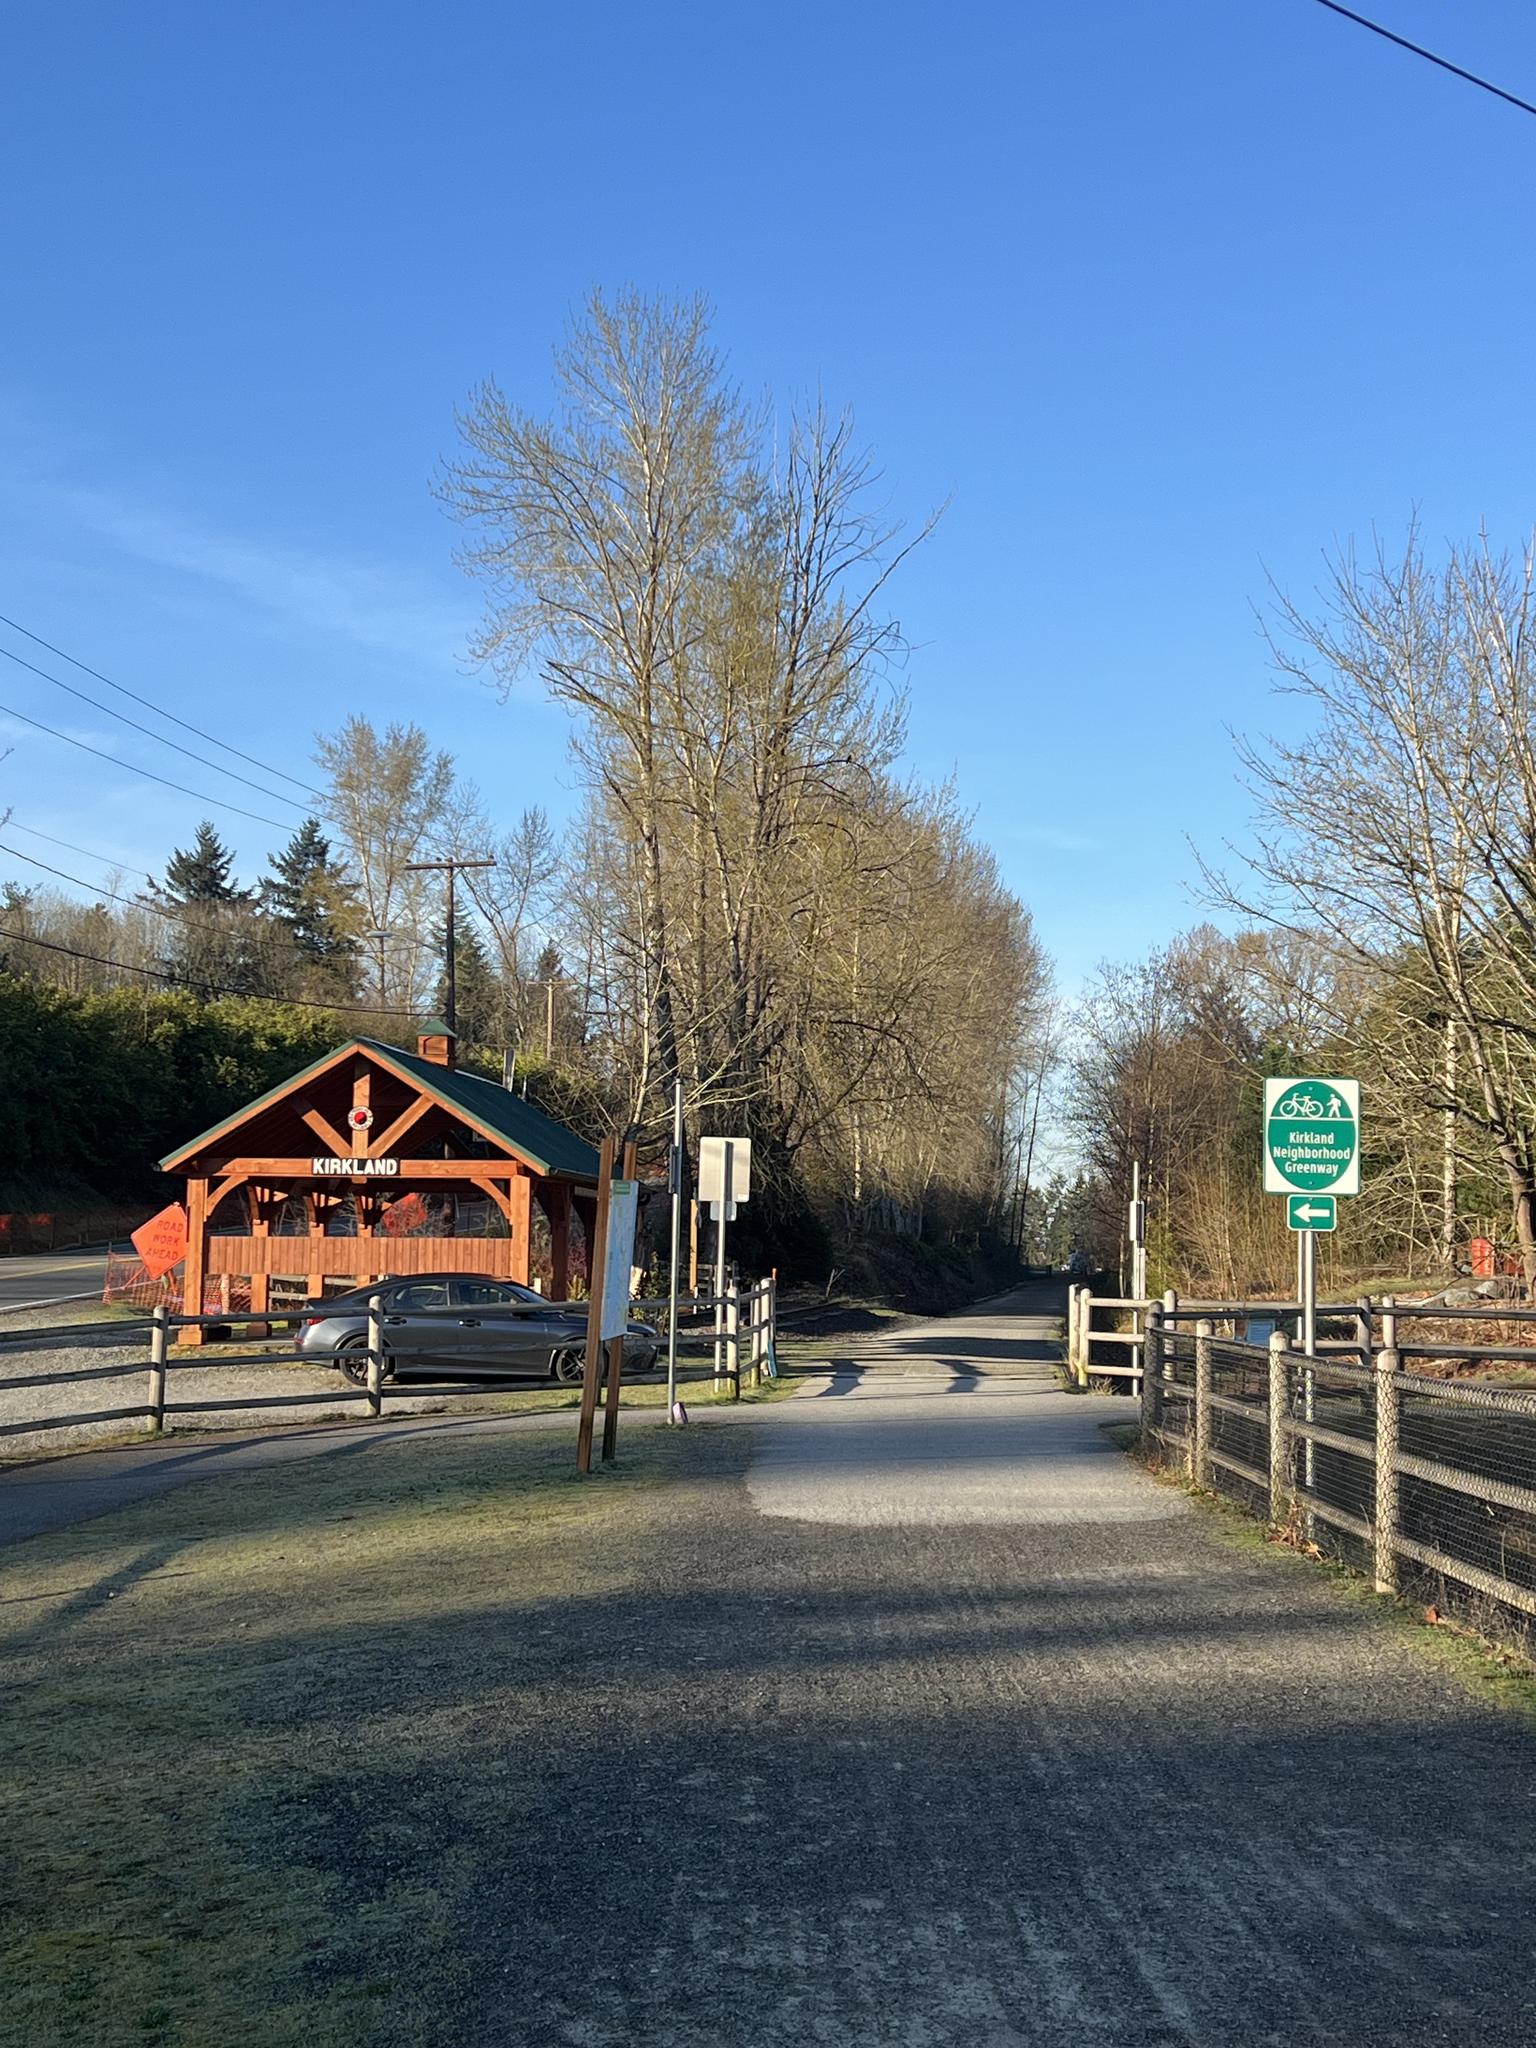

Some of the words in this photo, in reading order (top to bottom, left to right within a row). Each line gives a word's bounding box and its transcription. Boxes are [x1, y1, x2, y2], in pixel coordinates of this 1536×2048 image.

[1289, 1131, 1335, 1145] Kirkland
[1272, 1146, 1351, 1161] Neighborhood
[313, 1158, 397, 1175] KIRKLAND
[1284, 1161, 1339, 1177] Greenway
[157, 1219, 184, 1233] ROAD
[153, 1234, 180, 1247] WORK
[145, 1247, 178, 1261] AHEAD
